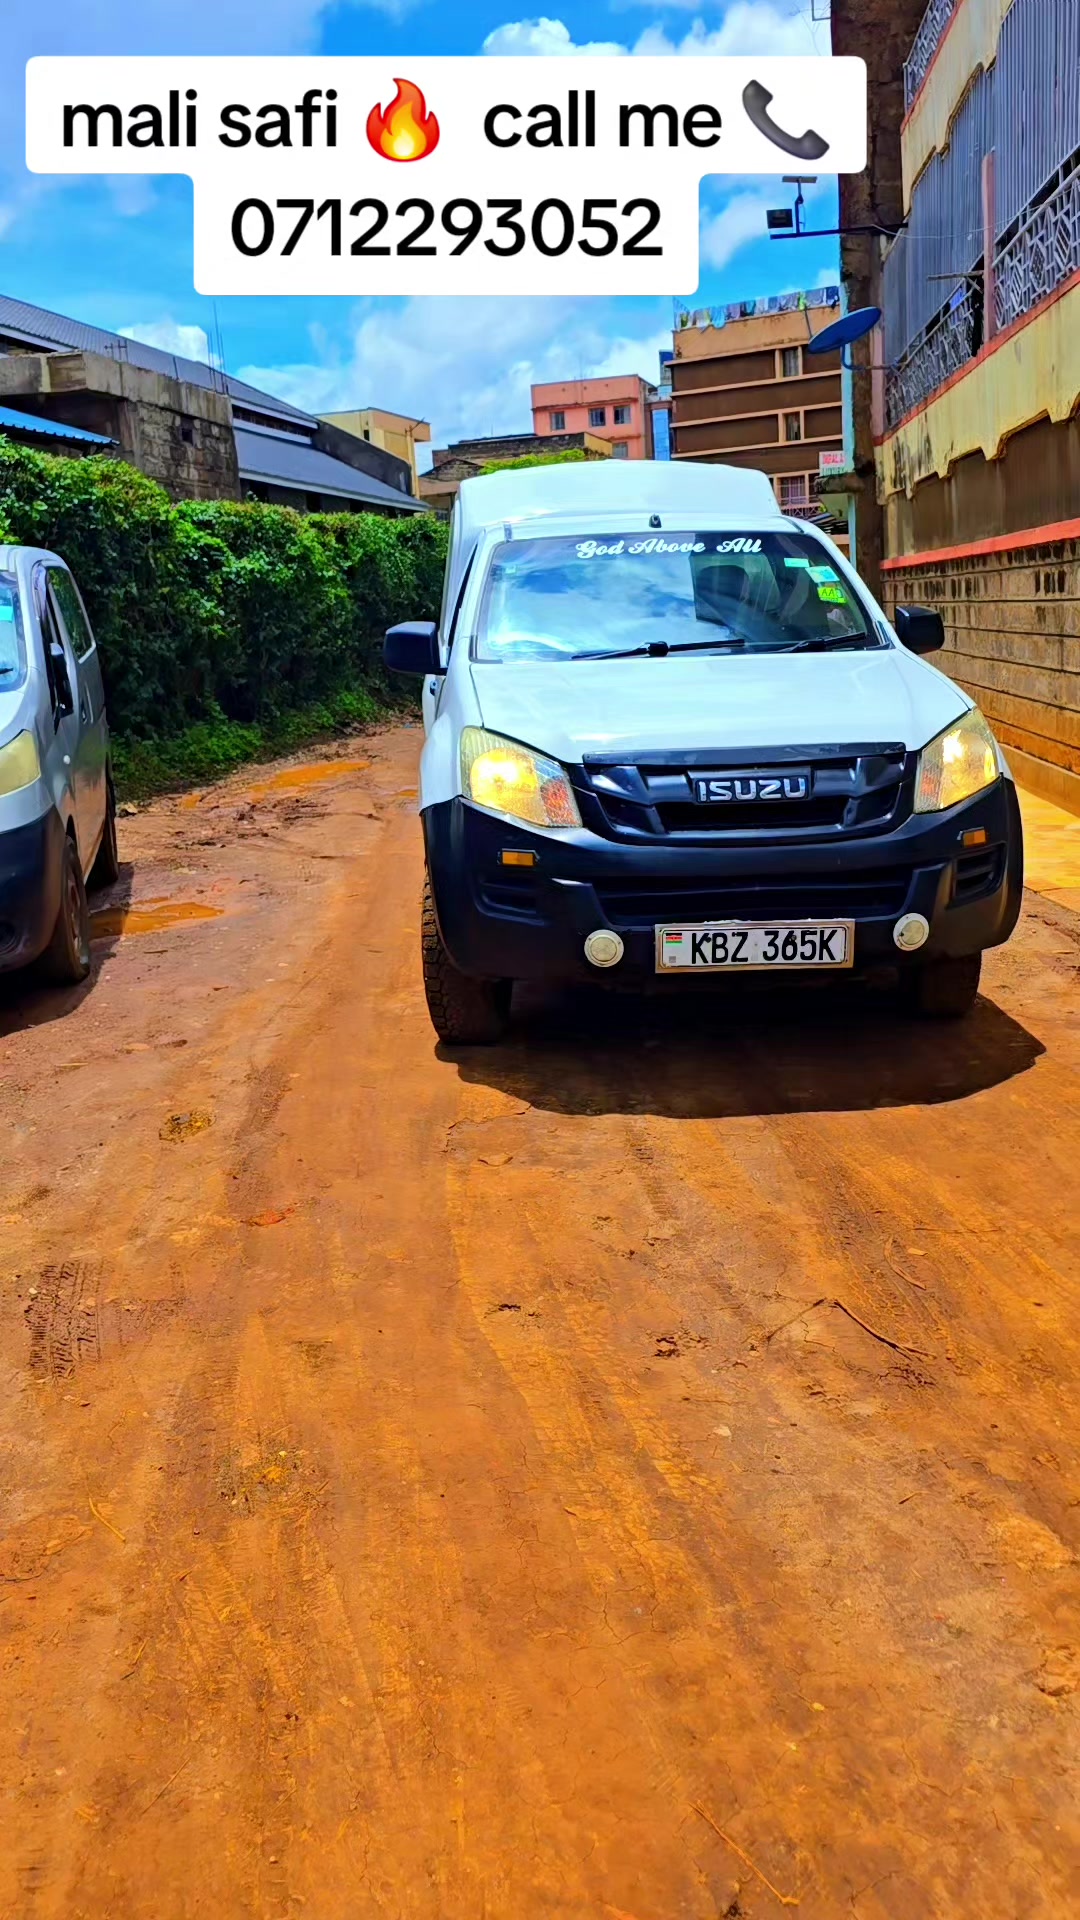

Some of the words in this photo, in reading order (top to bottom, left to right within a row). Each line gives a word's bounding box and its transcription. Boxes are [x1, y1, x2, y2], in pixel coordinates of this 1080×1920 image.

[576, 540, 625, 559] God
[628, 538, 706, 554] Above
[717, 537, 762, 553] All
[698, 777, 806, 802] ISUZU
[691, 931, 749, 965] KBZ
[762, 929, 837, 962] 365K
